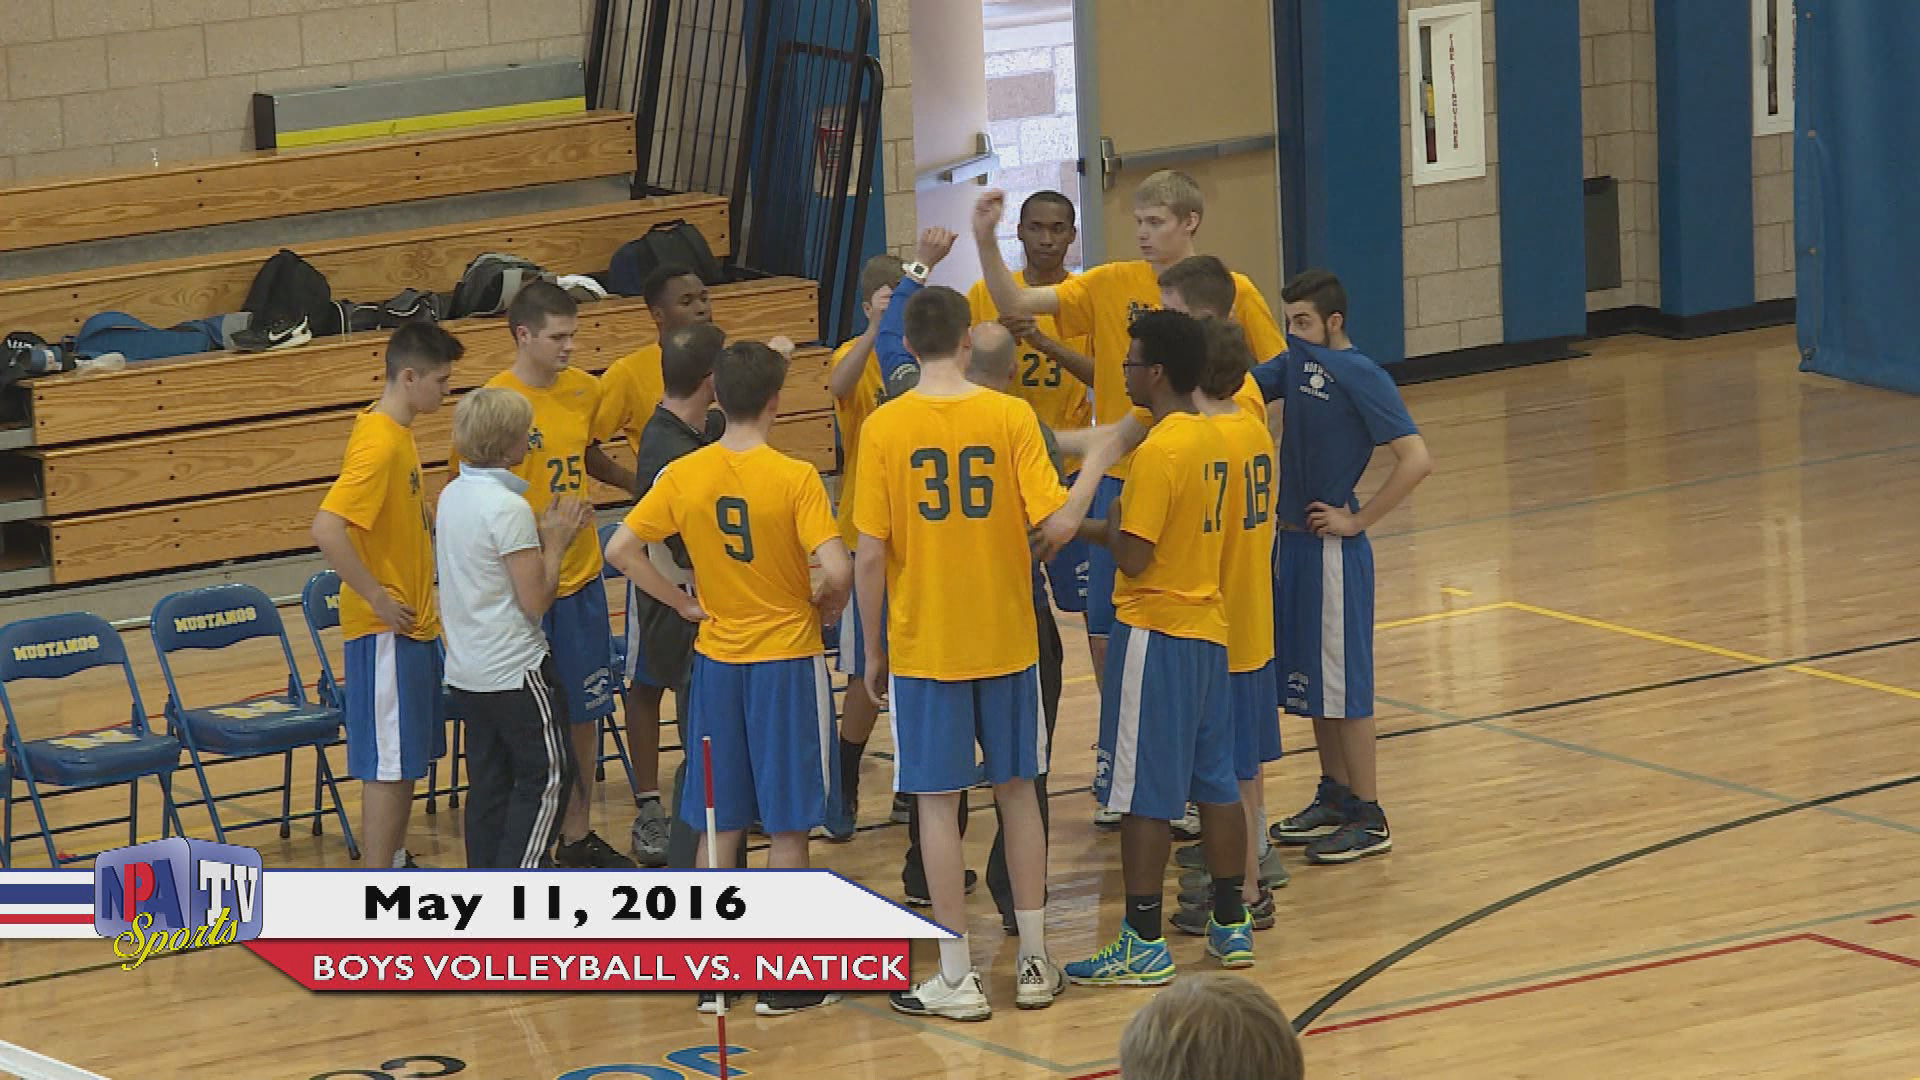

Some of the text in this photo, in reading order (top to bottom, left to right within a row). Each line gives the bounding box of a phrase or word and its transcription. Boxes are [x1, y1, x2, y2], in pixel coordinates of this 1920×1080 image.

[1021, 352, 1062, 387] 23
[546, 455, 582, 493] 25
[910, 445, 996, 521] 36
[1243, 453, 1273, 531] 18
[716, 496, 755, 563] 9
[173, 606, 257, 633] MUSTANGS
[13, 635, 100, 661] MUSTANGS
